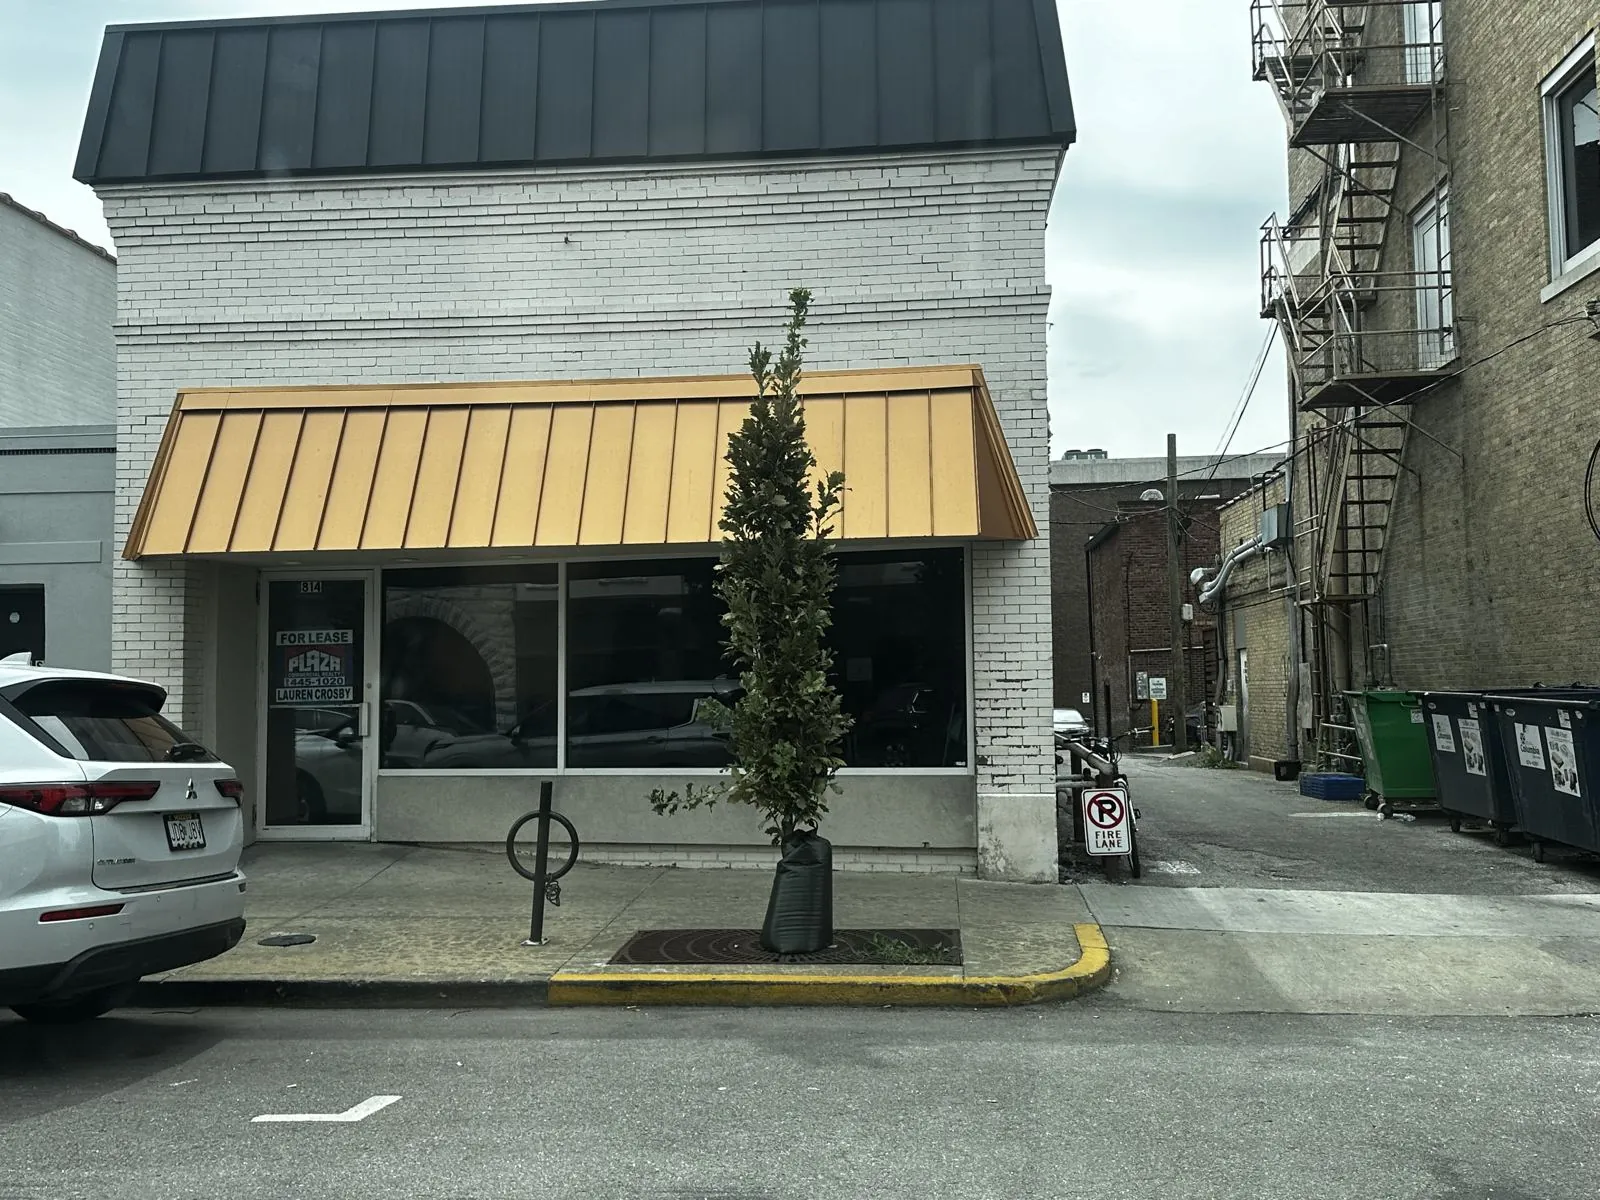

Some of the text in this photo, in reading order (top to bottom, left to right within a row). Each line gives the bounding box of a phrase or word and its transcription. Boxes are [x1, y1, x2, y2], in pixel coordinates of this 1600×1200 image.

[302, 582, 320, 592] 814
[281, 632, 349, 644] FOR LEASE
[289, 650, 341, 672] PLAZA
[277, 688, 351, 701] LAUREN CROSBY
[1095, 831, 1121, 839] FIRE
[1095, 840, 1122, 848] LANE
